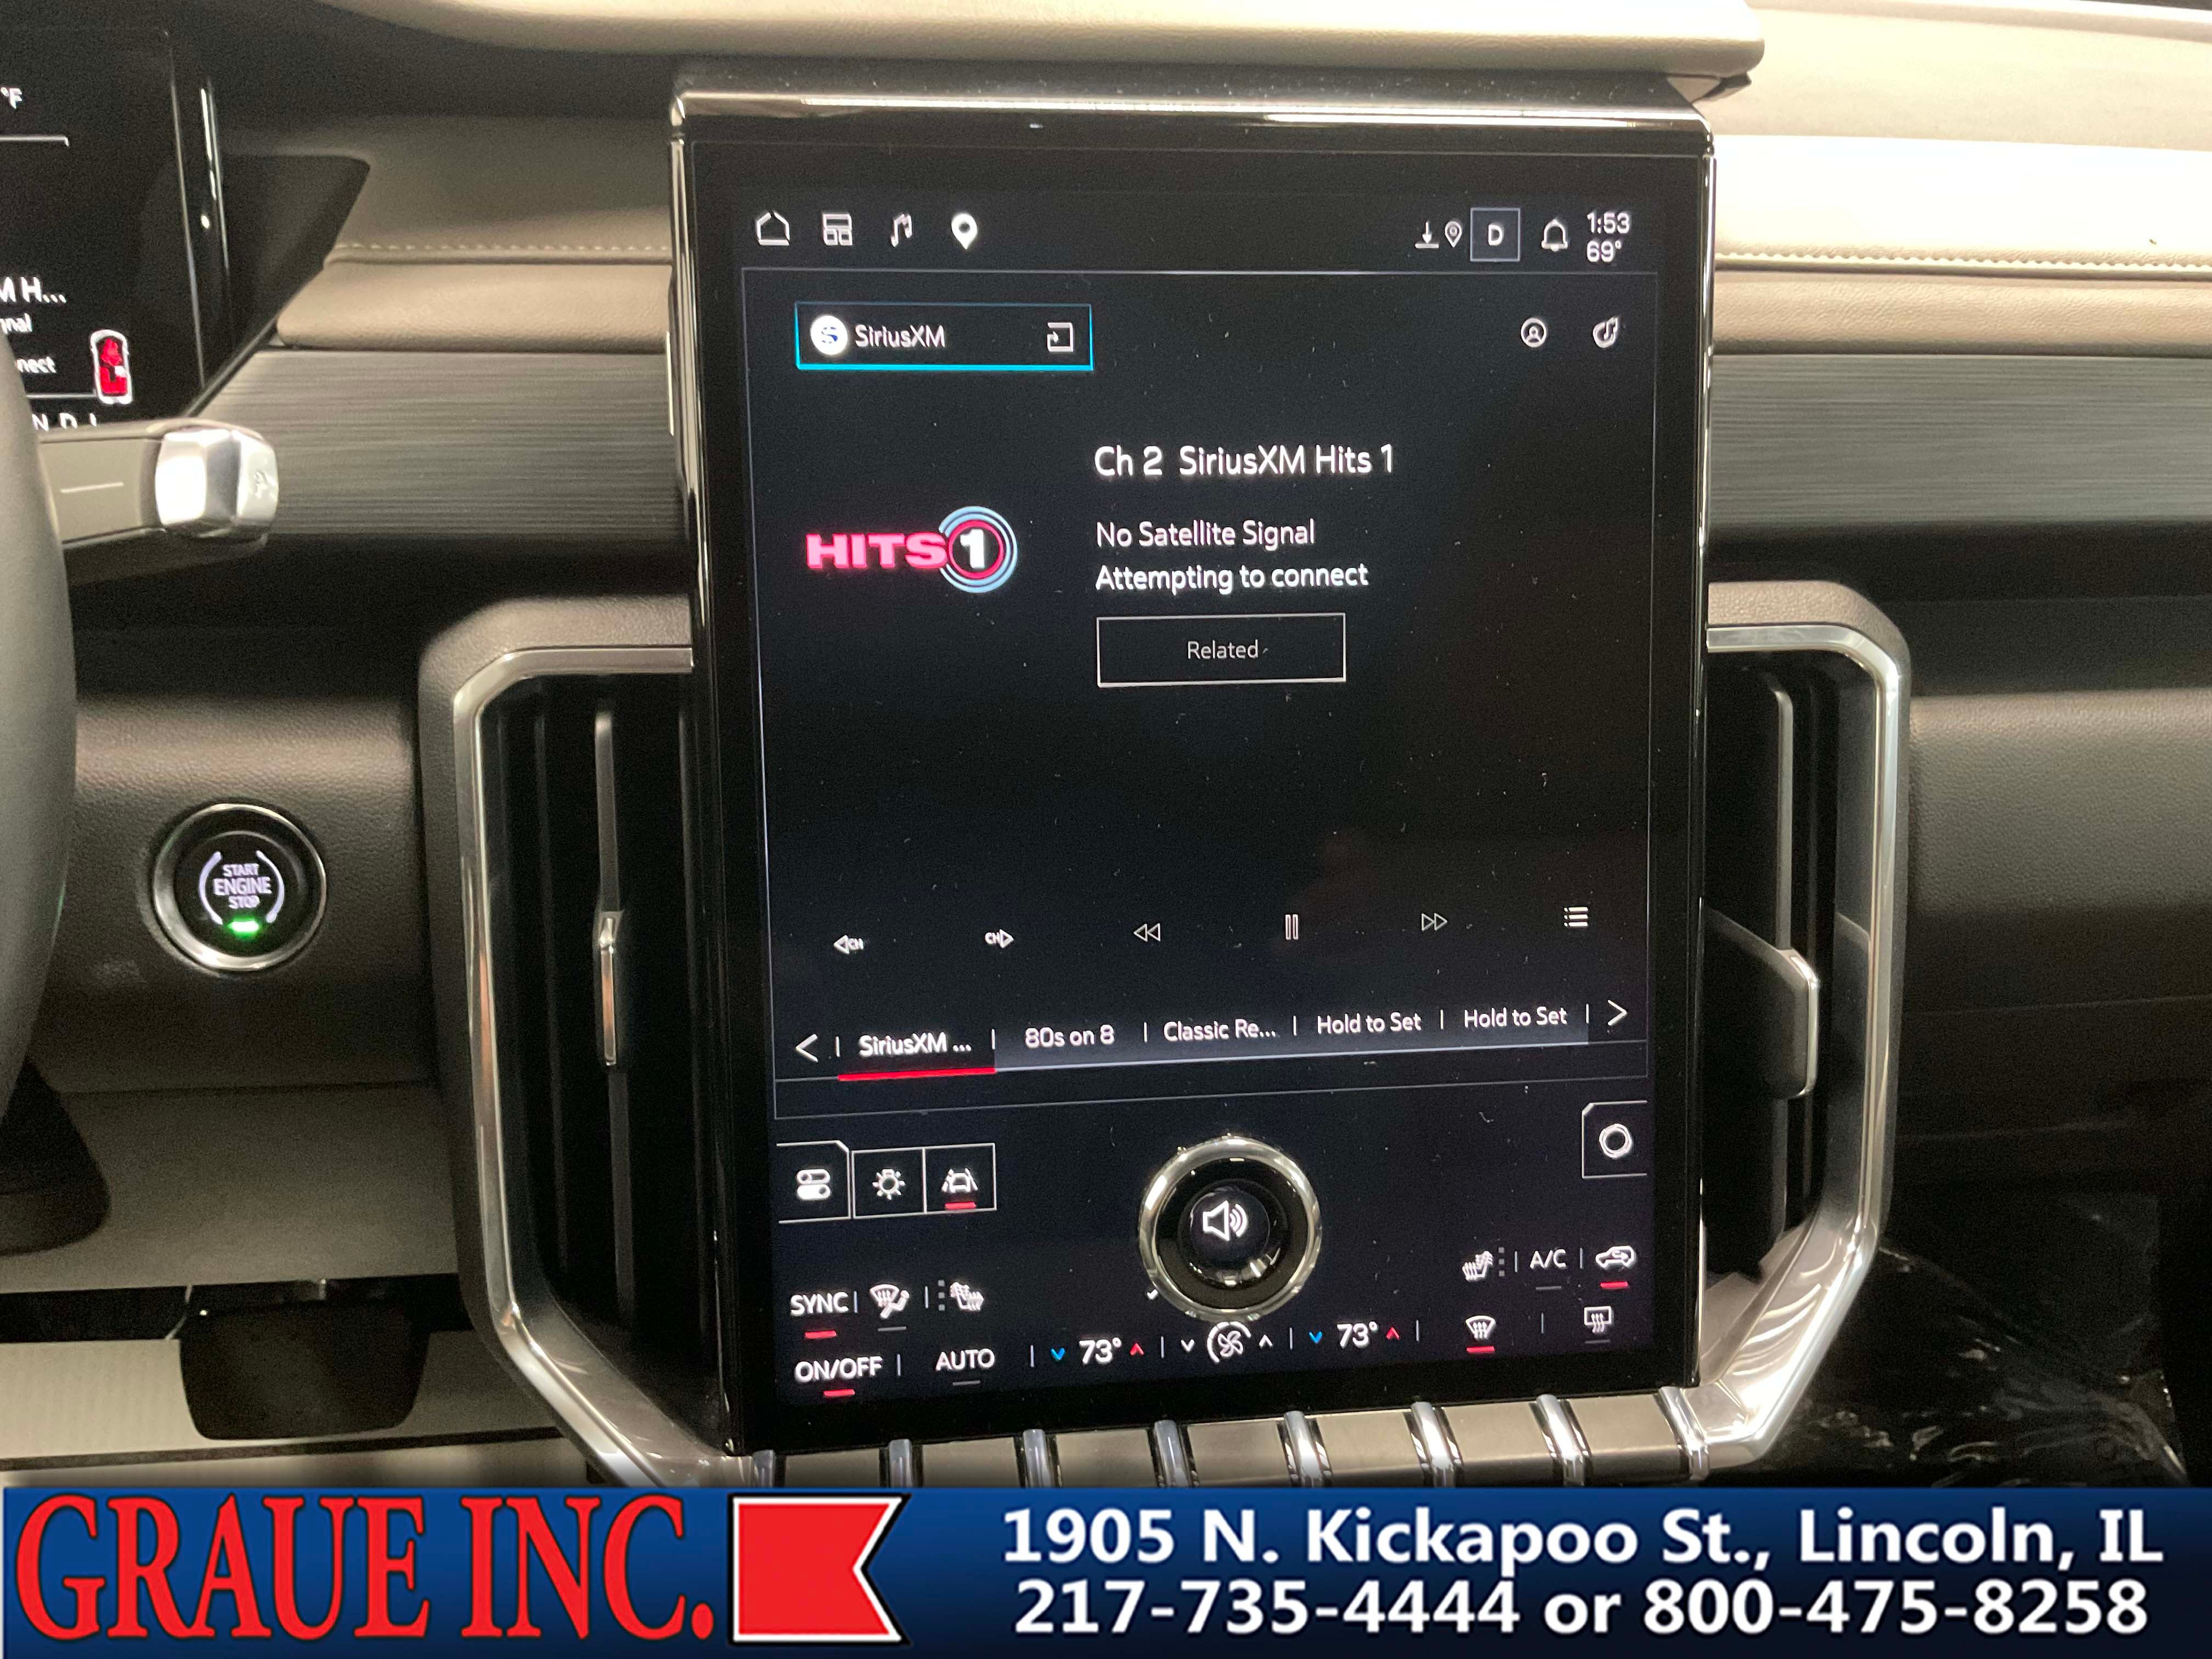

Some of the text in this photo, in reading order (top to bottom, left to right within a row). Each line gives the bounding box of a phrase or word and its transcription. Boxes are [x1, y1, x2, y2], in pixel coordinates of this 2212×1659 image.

[1488, 223, 1504, 246] D
[1587, 211, 1630, 235] 1:53
[1586, 239, 1622, 263] 69°
[20, 276, 66, 303] H...
[855, 324, 945, 348] SiriusXM
[1094, 443, 1393, 477] Ch 2 SiriusXM Hits 1
[1097, 518, 1315, 551] No Satellite Signal
[805, 528, 985, 571] HITS 1
[1095, 563, 1369, 596] Attempting to connect
[1188, 639, 1259, 659] Related
[222, 863, 259, 877] START
[213, 877, 272, 895] ENGINE
[229, 895, 260, 909] STOP
[1317, 1012, 1422, 1035] Hold to Set
[1464, 1006, 1568, 1028] Hold to Set
[1025, 1024, 1115, 1048] 80s on 8
[1164, 1018, 1276, 1042] Classic Re...
[859, 1031, 947, 1057] SiriusXM
[1530, 1248, 1567, 1269] A/C
[791, 1291, 849, 1317] SYNC
[1336, 1321, 1378, 1348] 73°
[935, 1348, 995, 1371] AUTO
[1079, 1336, 1122, 1364] 73°
[794, 1355, 883, 1383] ON/OFF
